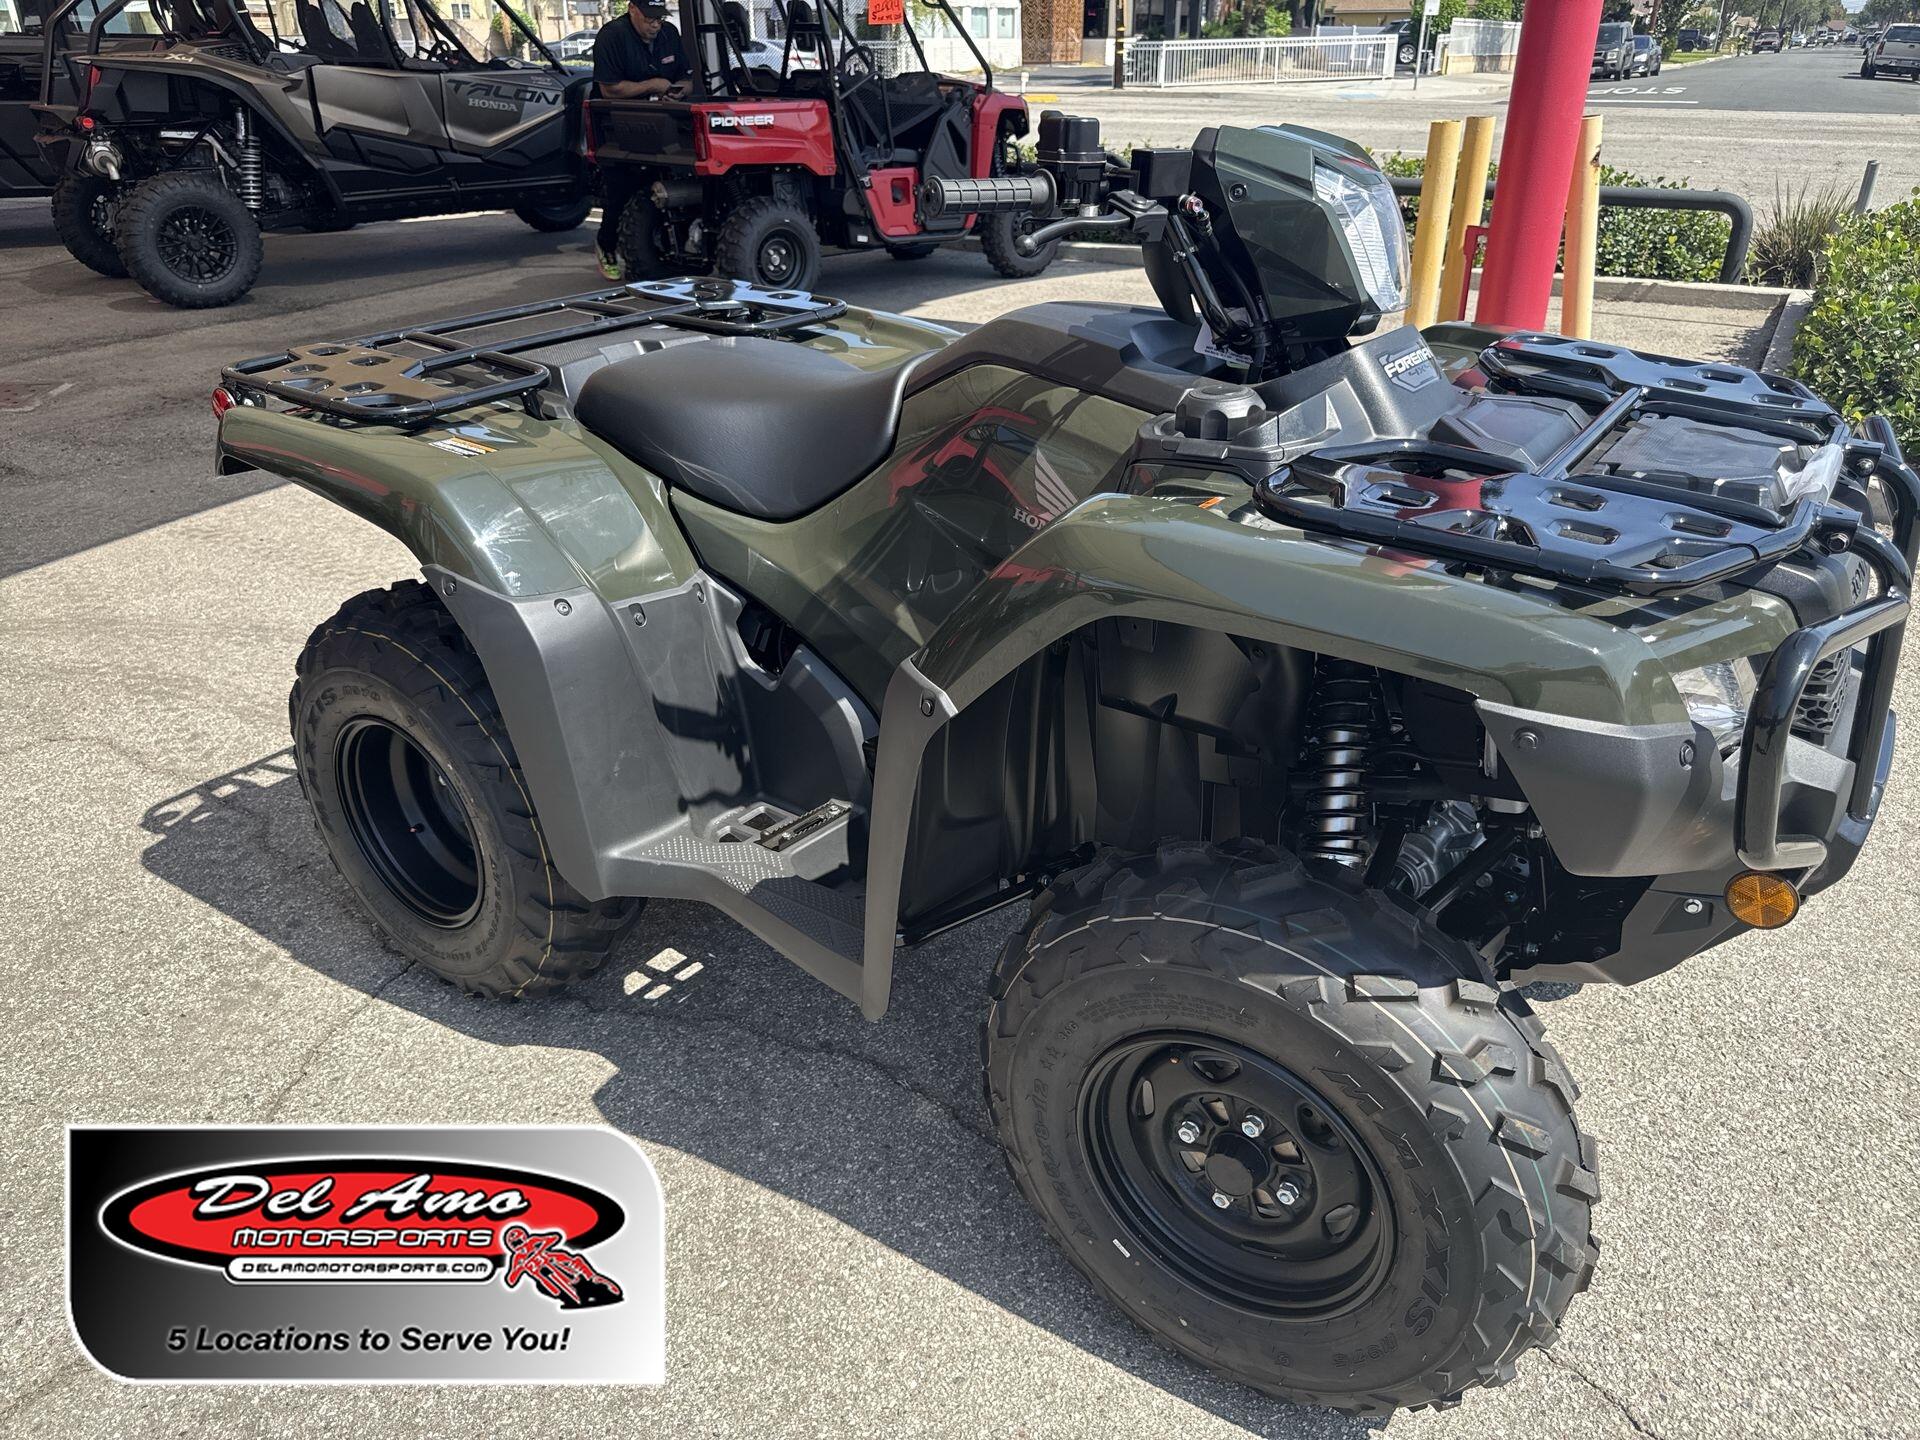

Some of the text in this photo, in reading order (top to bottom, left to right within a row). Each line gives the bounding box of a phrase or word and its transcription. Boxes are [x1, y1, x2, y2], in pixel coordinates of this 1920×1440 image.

[447, 79, 560, 105] TALON
[468, 98, 518, 112] HONDA
[710, 115, 775, 127] PIONEER
[1384, 347, 1433, 378] FOREMA
[1013, 506, 1047, 531] HON
